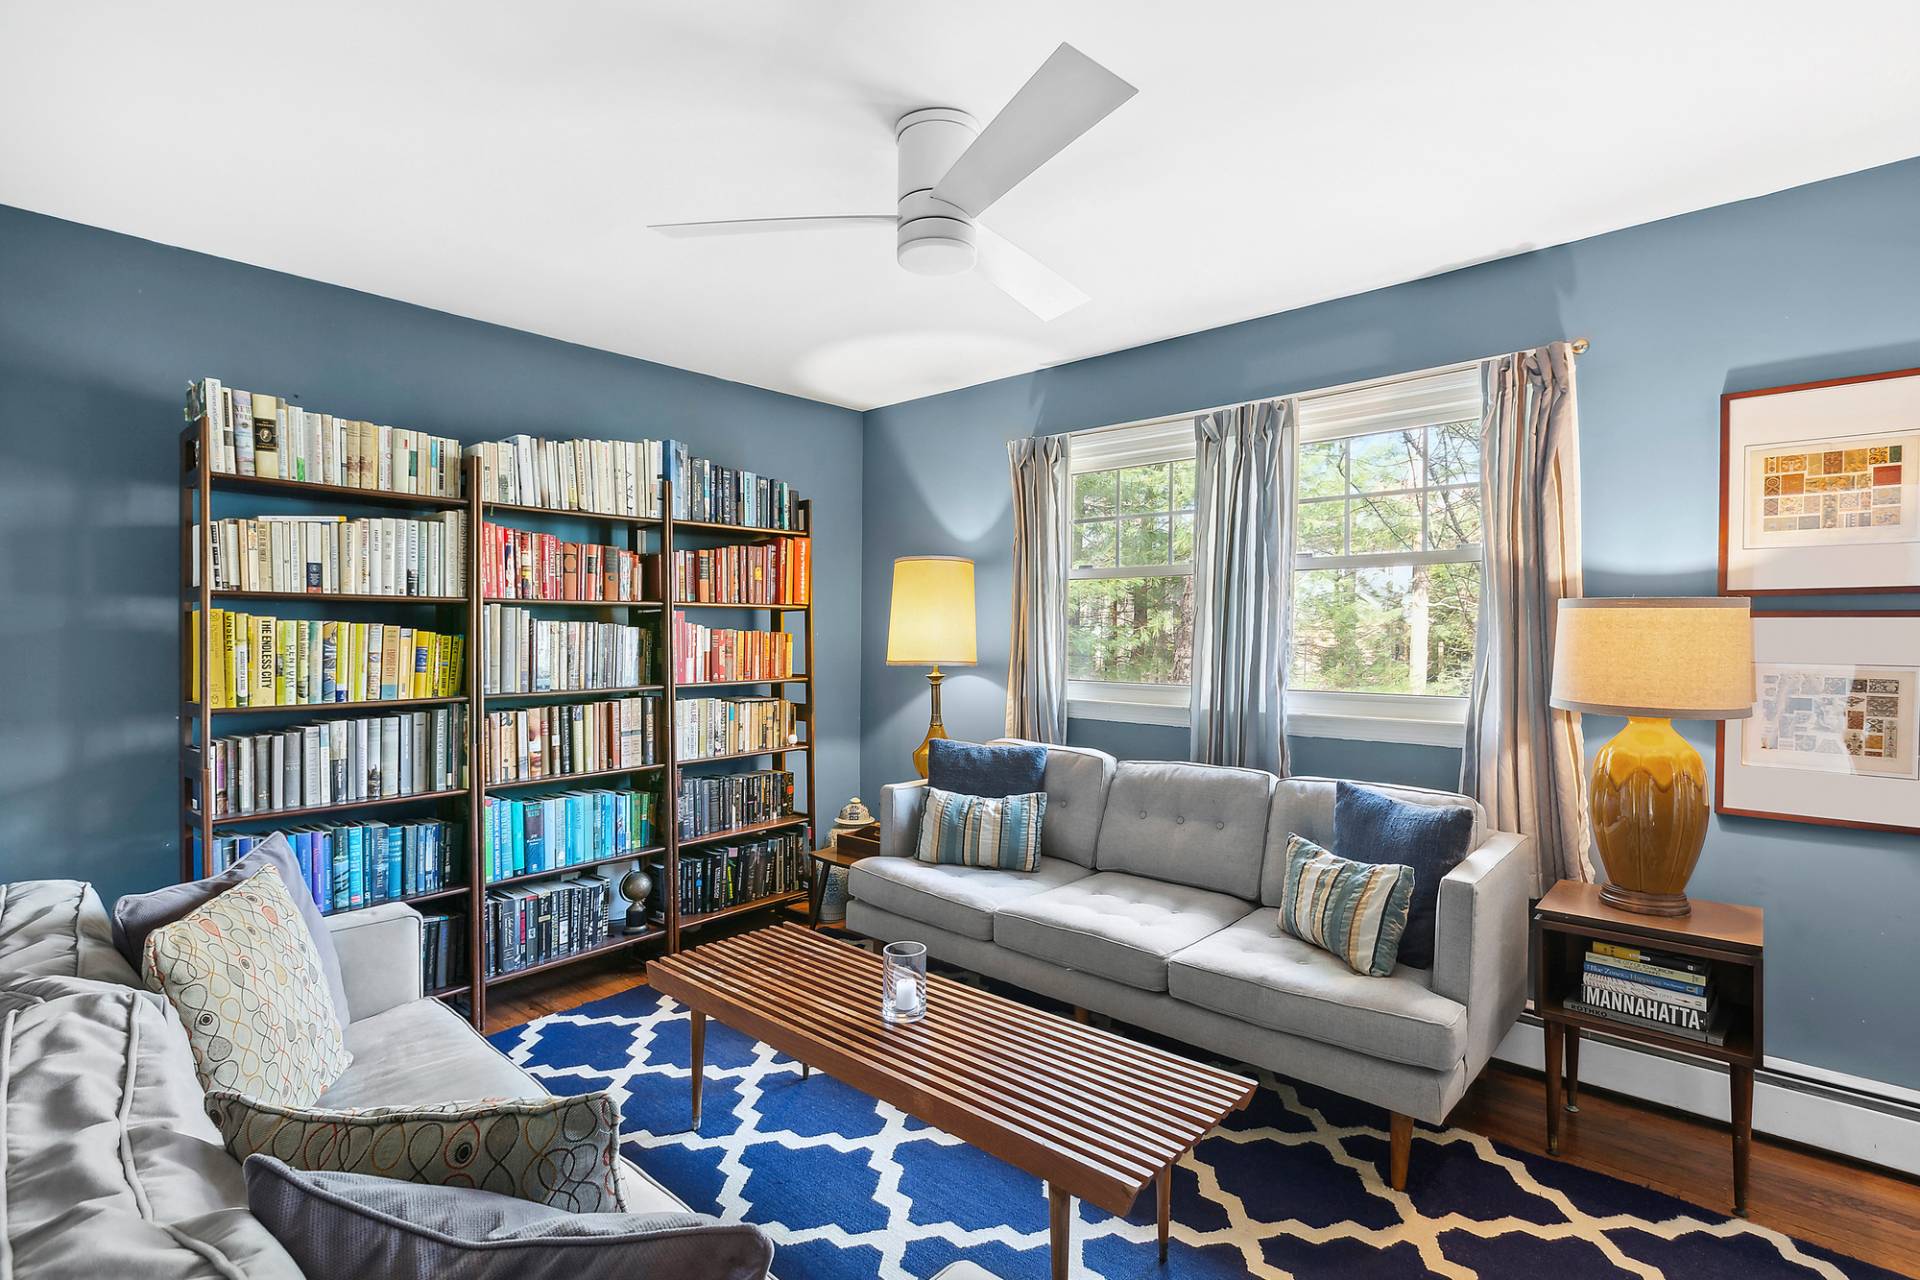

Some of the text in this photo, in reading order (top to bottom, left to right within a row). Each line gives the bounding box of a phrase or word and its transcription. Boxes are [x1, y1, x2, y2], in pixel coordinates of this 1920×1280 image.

[261, 620, 272, 689] THE ENDLESS CITY
[287, 644, 295, 689] CENTURY
[1570, 1003, 1608, 1018] ROTHKO
[1586, 986, 1701, 1030] MANNAHATTA
